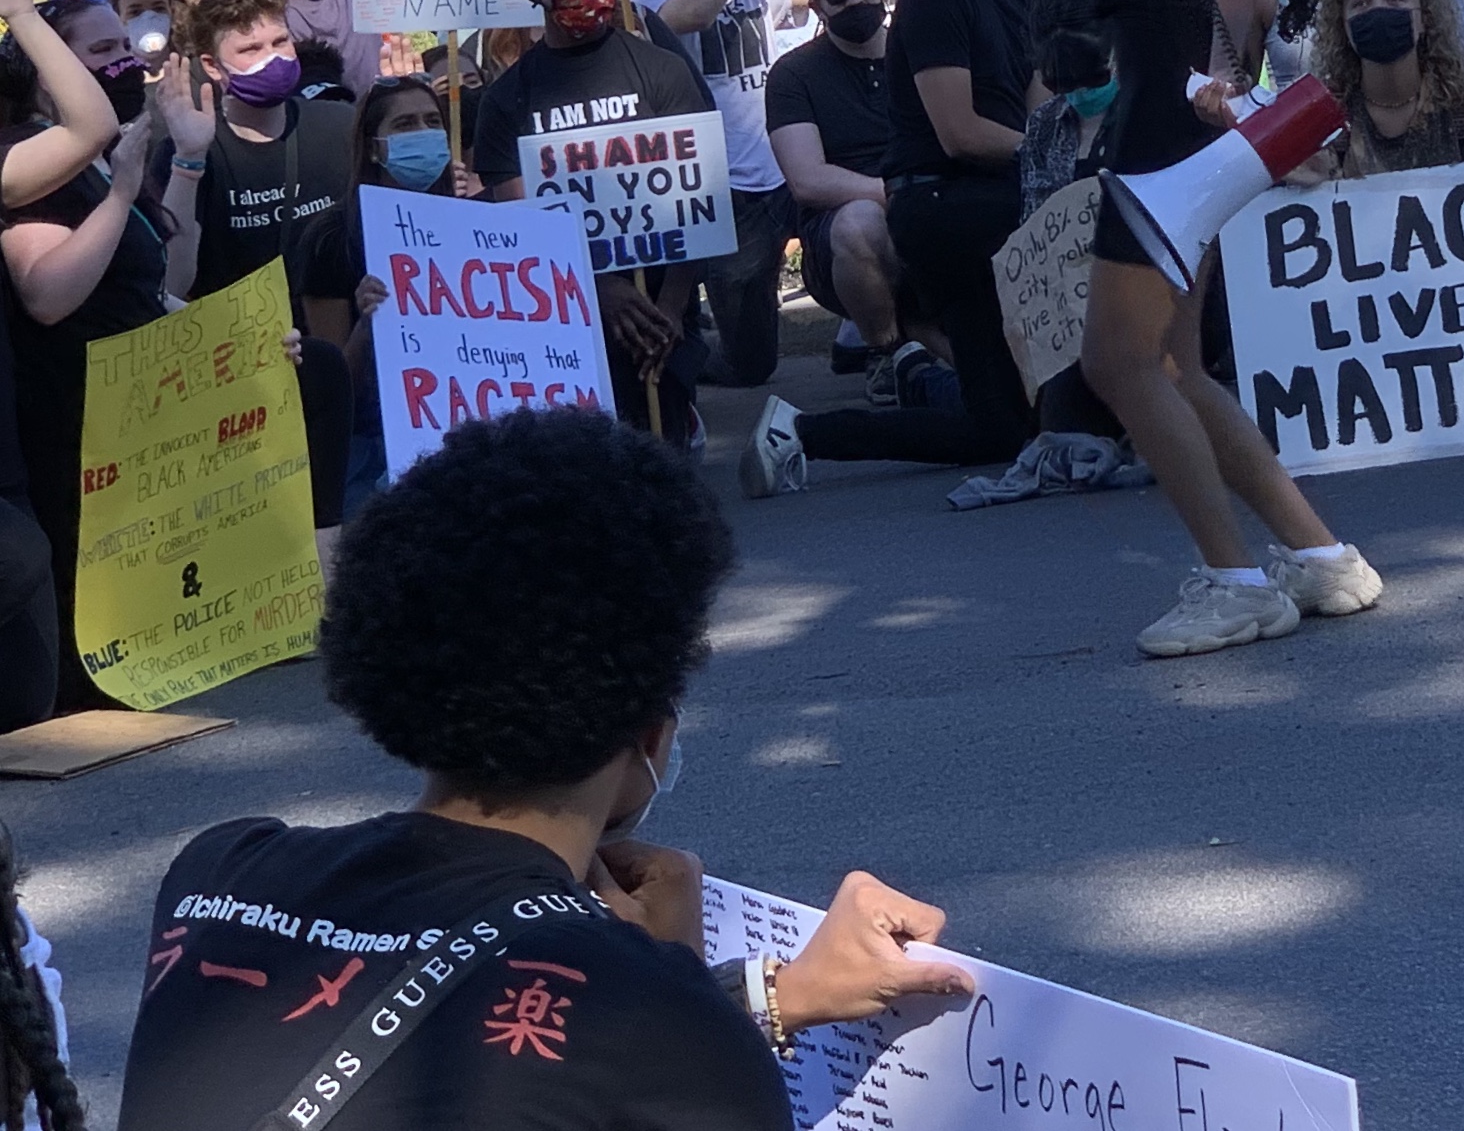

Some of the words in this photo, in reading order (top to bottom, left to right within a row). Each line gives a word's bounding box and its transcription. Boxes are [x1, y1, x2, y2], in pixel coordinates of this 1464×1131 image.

[532, 111, 545, 134] I
[550, 102, 588, 132] AM
[590, 93, 640, 123] NOT
[539, 128, 698, 179] SHAME
[617, 162, 702, 200] YOU
[229, 189, 237, 206] I
[239, 182, 301, 206] alrea
[229, 210, 271, 229] miss
[675, 195, 717, 227] IN
[394, 204, 442, 250] the
[472, 226, 519, 250] new
[588, 228, 688, 270] BLUE
[1004, 231, 1049, 283] Only
[1044, 206, 1072, 243] 8%
[1077, 191, 1100, 225] of
[388, 252, 593, 327] RACISM
[1018, 274, 1049, 306] city
[1056, 237, 1089, 279] poli
[88, 301, 204, 388] THIS
[227, 265, 279, 338] IS
[1020, 308, 1051, 341] live
[1053, 286, 1068, 313] in
[400, 326, 422, 355] is
[456, 332, 528, 380] denying
[545, 343, 583, 373] that
[125, 446, 150, 471] THE
[152, 426, 211, 463] INNOCENT
[217, 405, 268, 447] BLOOD
[137, 459, 187, 503] BLACK
[196, 436, 262, 479] AMERICANS
[116, 548, 148, 570] THAT
[216, 498, 268, 531] AMERICA
[158, 506, 185, 534] THE
[192, 479, 247, 519] WHITE
[129, 623, 166, 651] THE
[173, 588, 238, 637] POLICE
[242, 573, 276, 608] NOT
[280, 559, 320, 589] HELD
[181, 560, 203, 599] &
[121, 635, 212, 689] RESPONSIBLE
[218, 619, 246, 648] FOR
[167, 675, 198, 695] RACE
[261, 640, 281, 658] IS
[306, 919, 411, 952] Ramen
[370, 921, 500, 1037] GUESS
[288, 1050, 362, 1129] ESS
[965, 993, 1126, 1131] George
